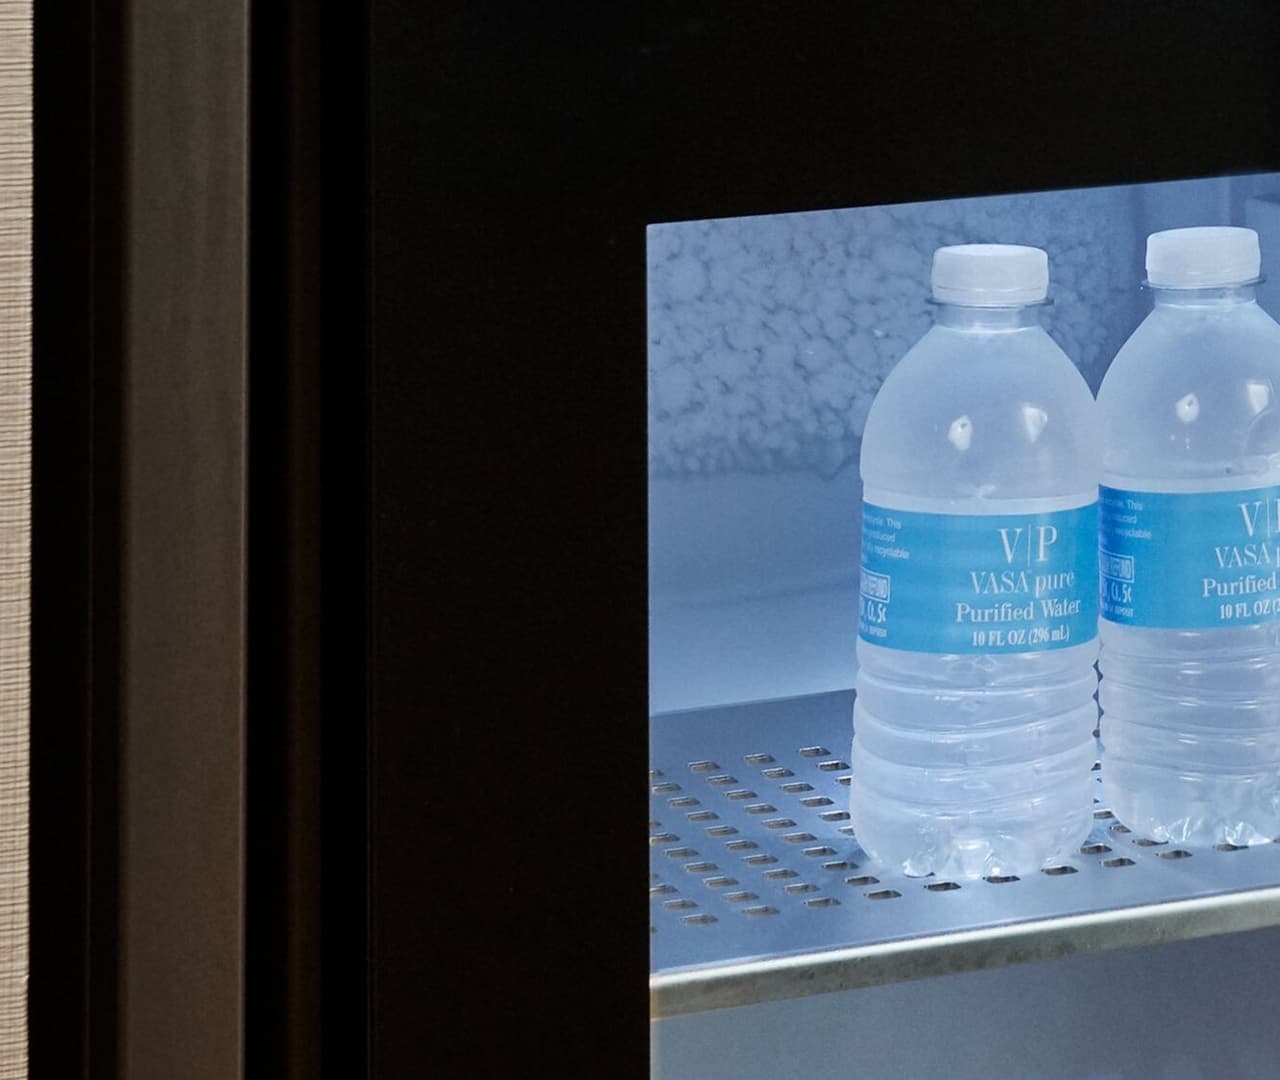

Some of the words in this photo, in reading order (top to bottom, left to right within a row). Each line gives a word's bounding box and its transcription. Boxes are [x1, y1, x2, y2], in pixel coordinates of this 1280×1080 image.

[1215, 542, 1271, 569] VASA
[970, 569, 1029, 595] VASA
[1035, 570, 1074, 598] pure
[1202, 571, 1277, 597] Purified
[956, 602, 1035, 623] Purified
[1040, 598, 1081, 619] Water
[1220, 604, 1232, 620] 10
[1235, 602, 1251, 619] FL
[1253, 599, 1271, 617] OZ
[973, 631, 985, 646] 10
[988, 630, 1005, 646] FL
[1008, 629, 1026, 645] OZ
[1028, 626, 1049, 647] (296
